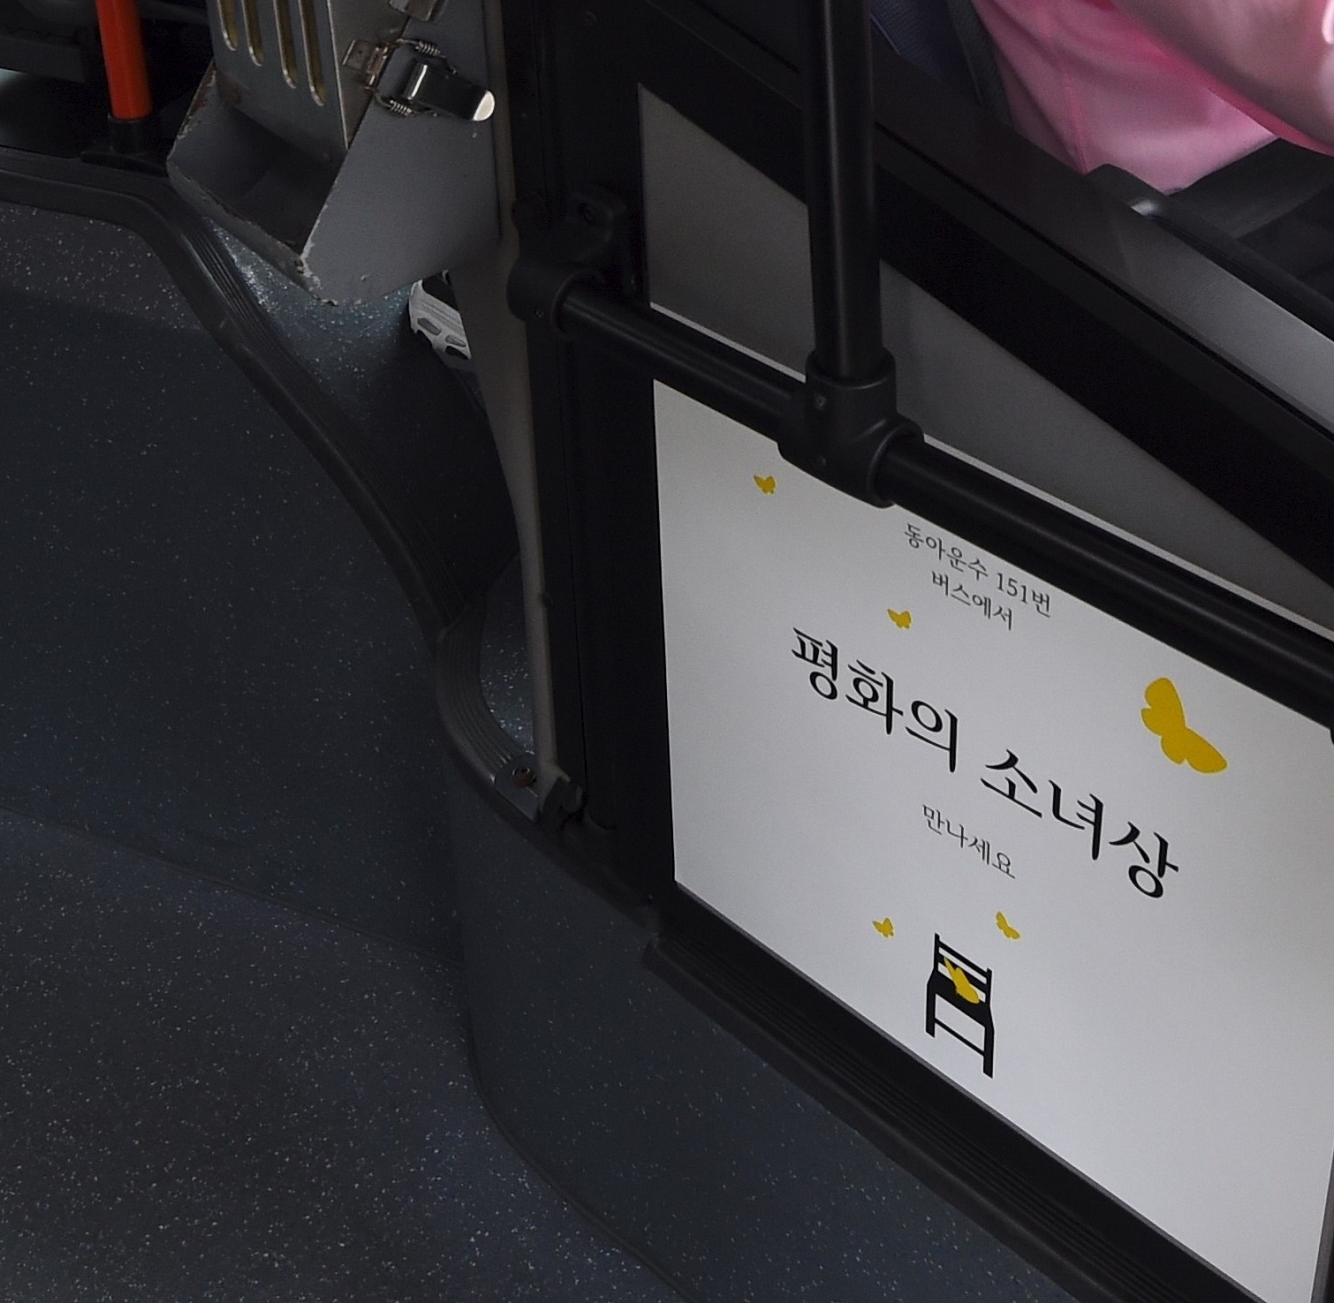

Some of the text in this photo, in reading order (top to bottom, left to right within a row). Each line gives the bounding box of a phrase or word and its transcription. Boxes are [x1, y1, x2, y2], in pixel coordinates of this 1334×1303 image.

[905, 524, 1053, 618] 동아운수 151번
[931, 572, 1015, 631] 버스에서
[791, 627, 1181, 899] 평화의 소녀상
[922, 805, 1017, 879] 만나세요
